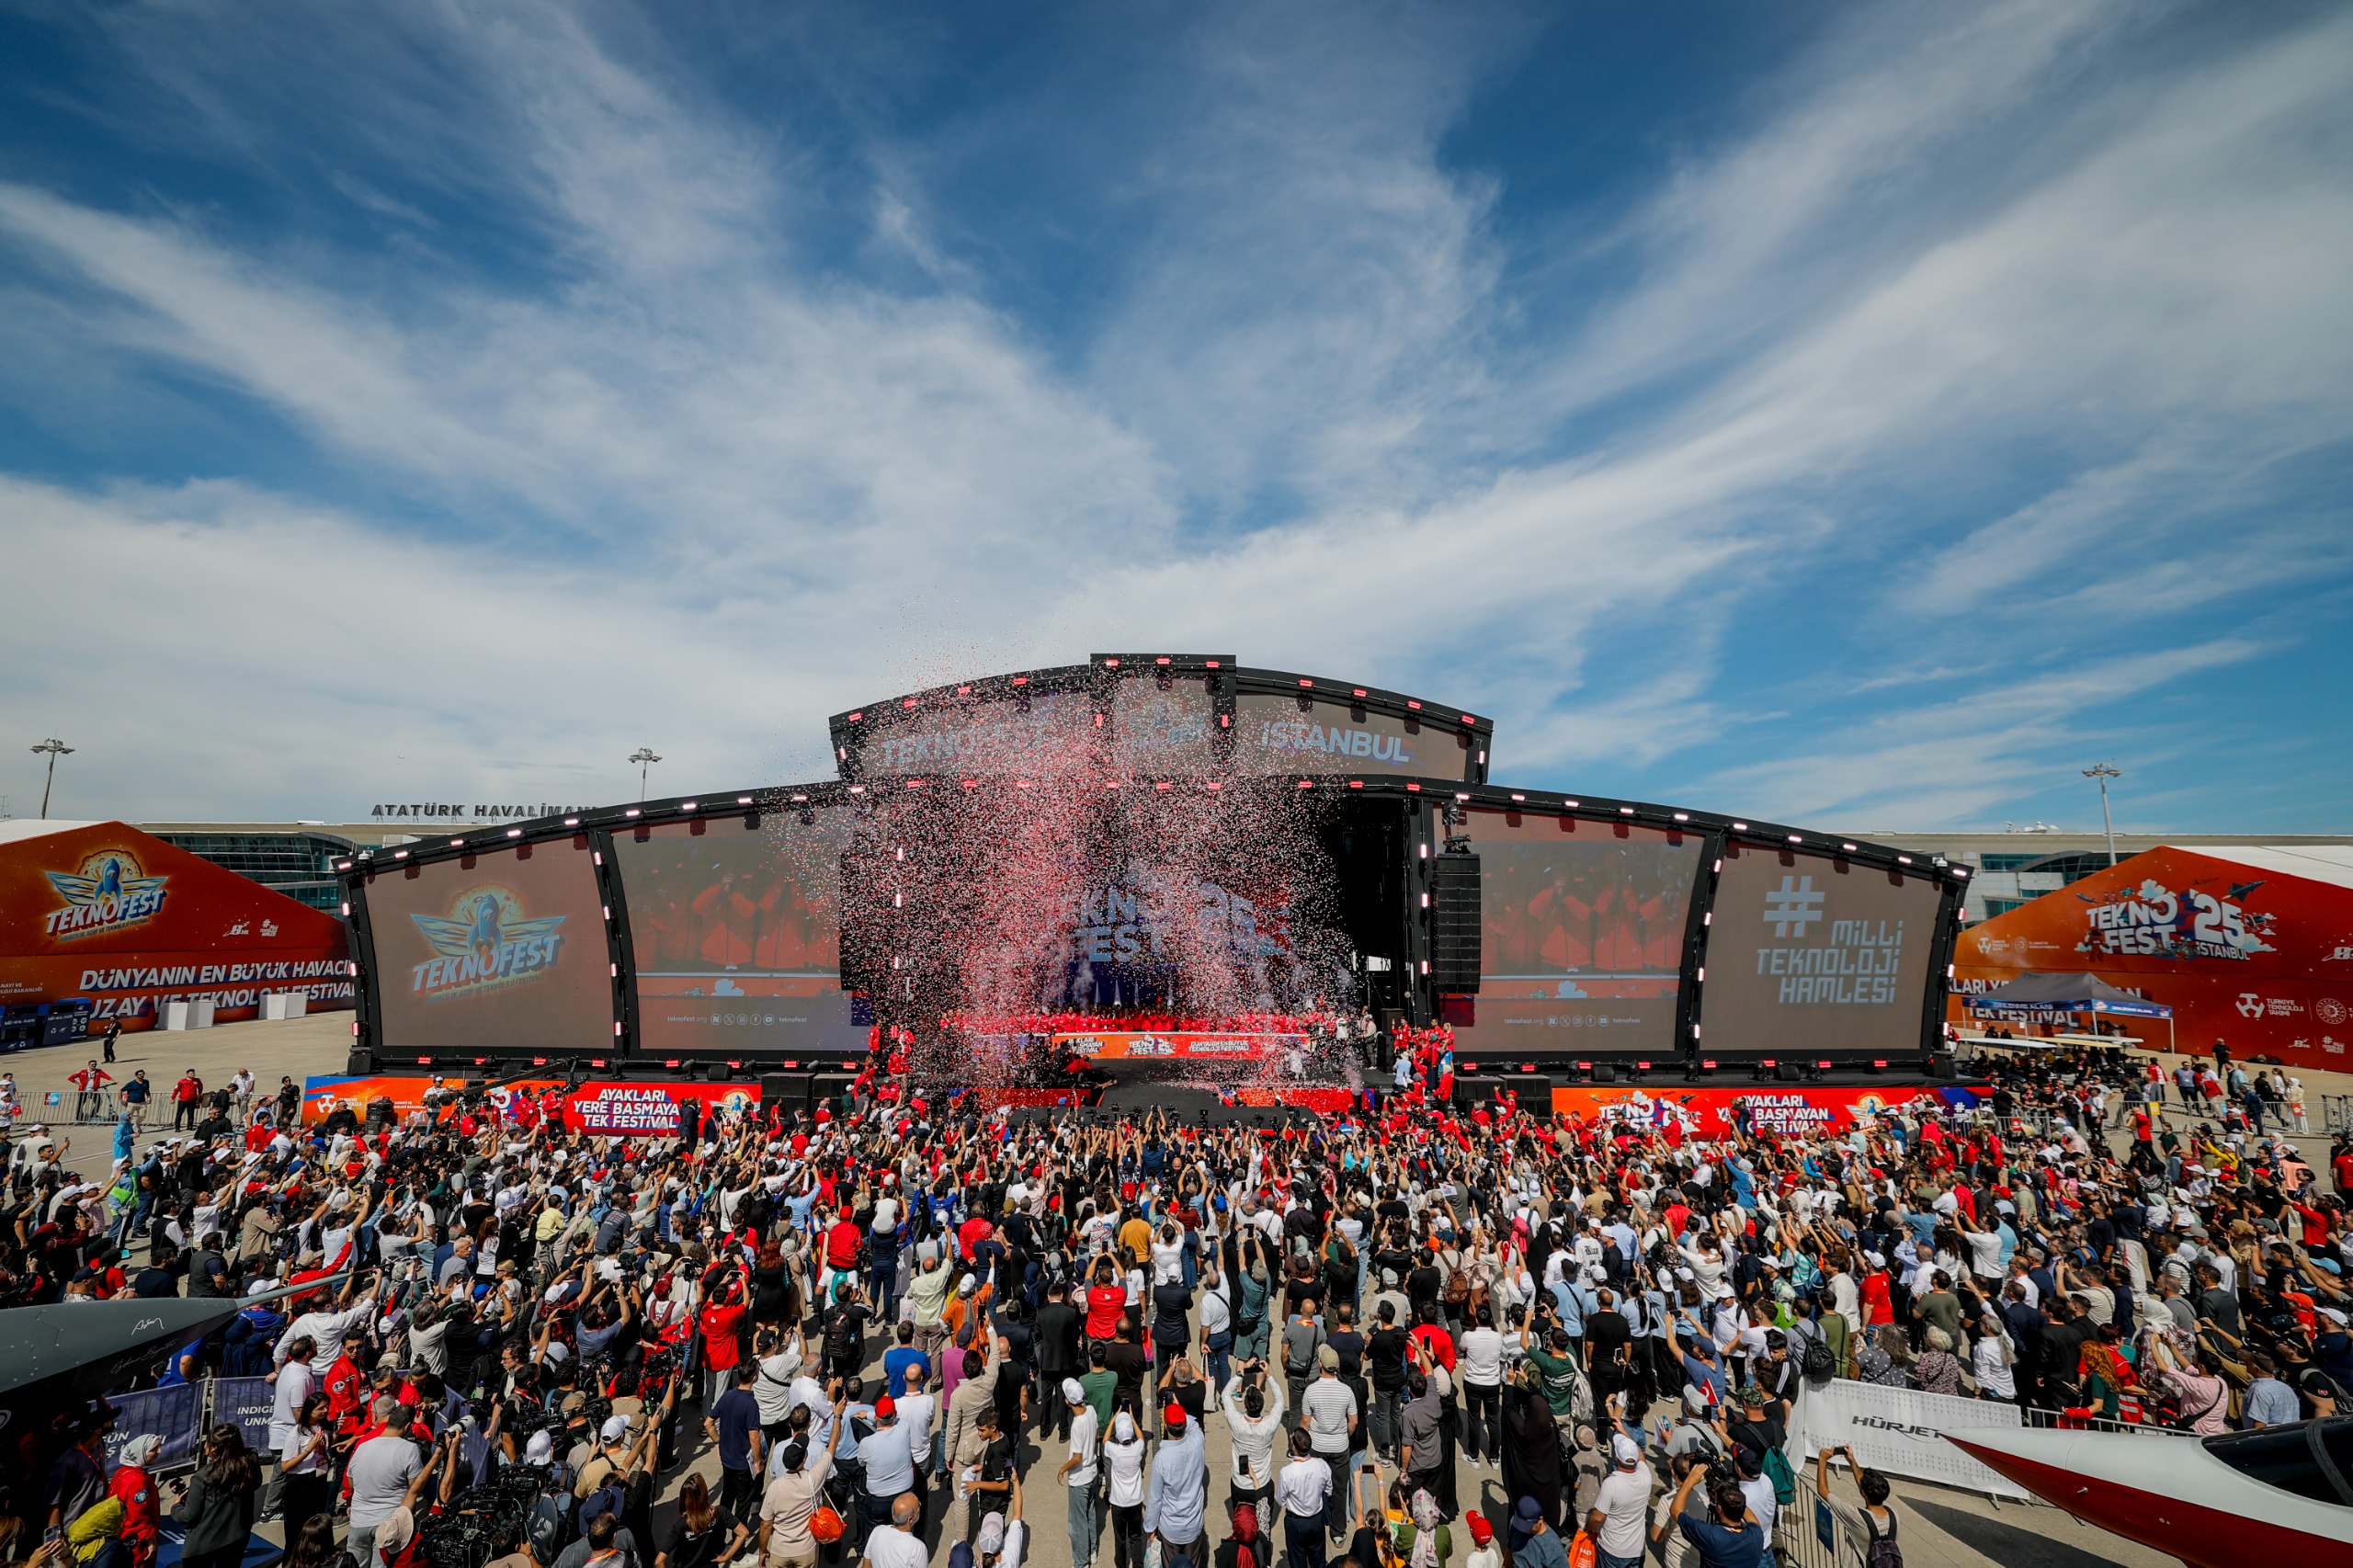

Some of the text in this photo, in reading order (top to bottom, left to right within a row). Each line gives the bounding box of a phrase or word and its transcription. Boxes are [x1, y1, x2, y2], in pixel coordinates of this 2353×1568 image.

[371, 802, 598, 817] ATATÜRK HAVALİMA
[46, 890, 166, 936] TEKNOFEST
[2086, 893, 2178, 929] TEKNO
[2104, 925, 2177, 955] FEST
[2197, 941, 2251, 960] İSTANBUL
[413, 934, 563, 994] TEKNOFEST
[1757, 949, 1900, 975] TEKNOLOJİ
[80, 966, 195, 990] DÜNYANIN
[199, 964, 227, 983] EN
[229, 962, 289, 982] BÜYÜK
[1779, 977, 1896, 1004] HAMLESİ
[1129, 1038, 1154, 1049] TEKNO
[597, 1088, 665, 1101] AYAKLARI
[574, 1101, 680, 1116] YERE BASMAYA
[1756, 1108, 1829, 1120] BASMAYAN
[584, 1114, 677, 1129] TEK FESTİVAL
[1852, 1415, 1941, 1439] HÜRJET
